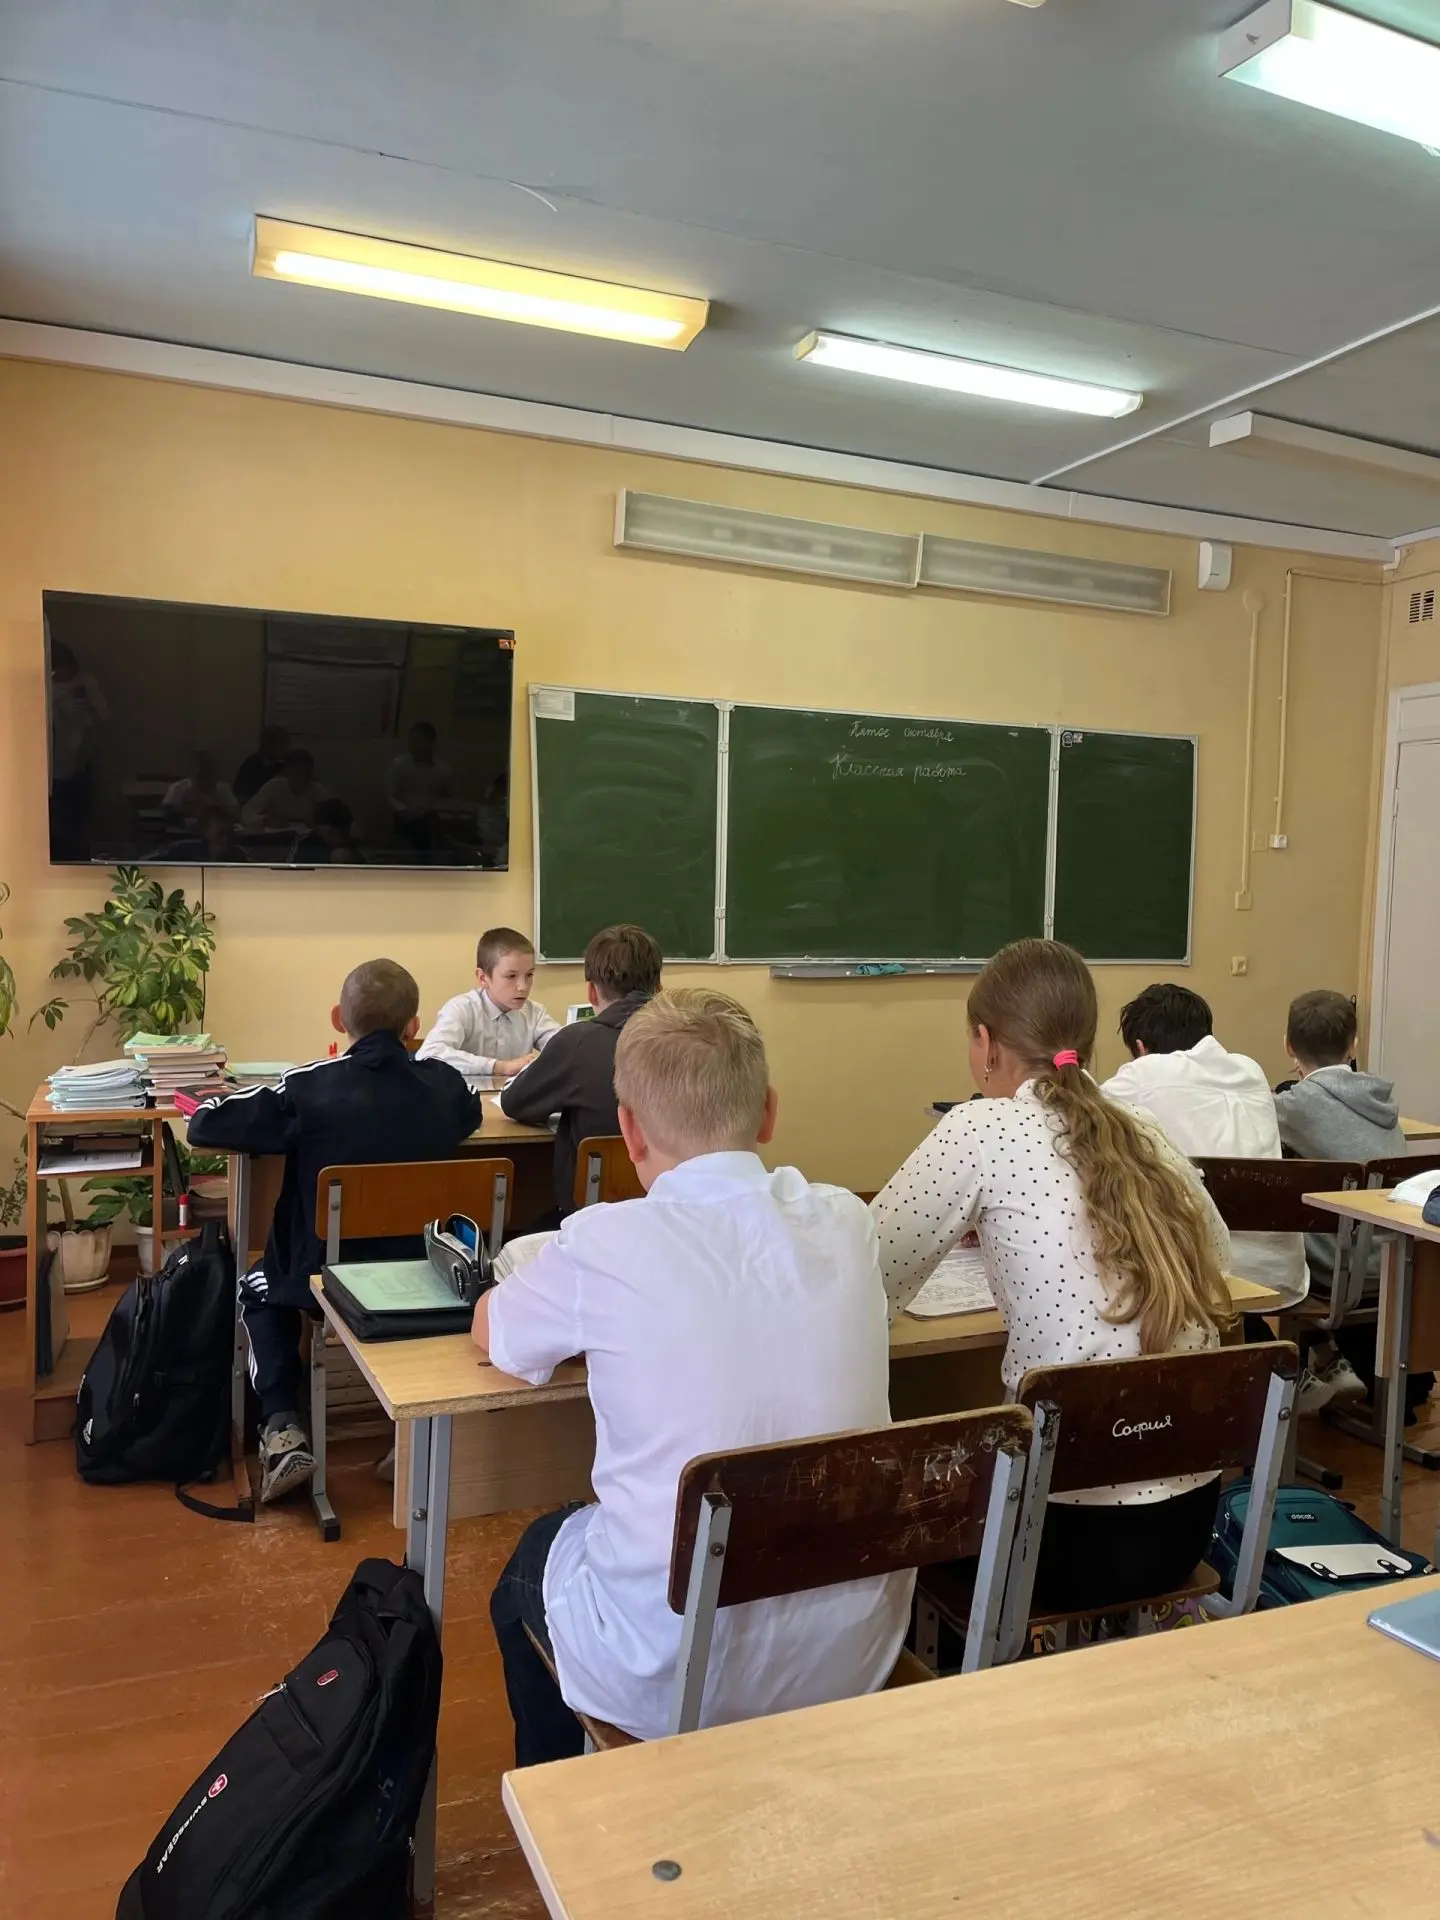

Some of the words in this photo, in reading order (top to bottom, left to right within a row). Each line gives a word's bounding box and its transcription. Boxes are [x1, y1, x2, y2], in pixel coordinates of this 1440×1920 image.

[848, 720, 890, 739] Пятое
[903, 727, 955, 746] октября
[829, 752, 904, 781] Классная
[913, 762, 967, 784] работа
[1112, 1415, 1173, 1441] София
[156, 1796, 208, 1874] SWISSGEAR
